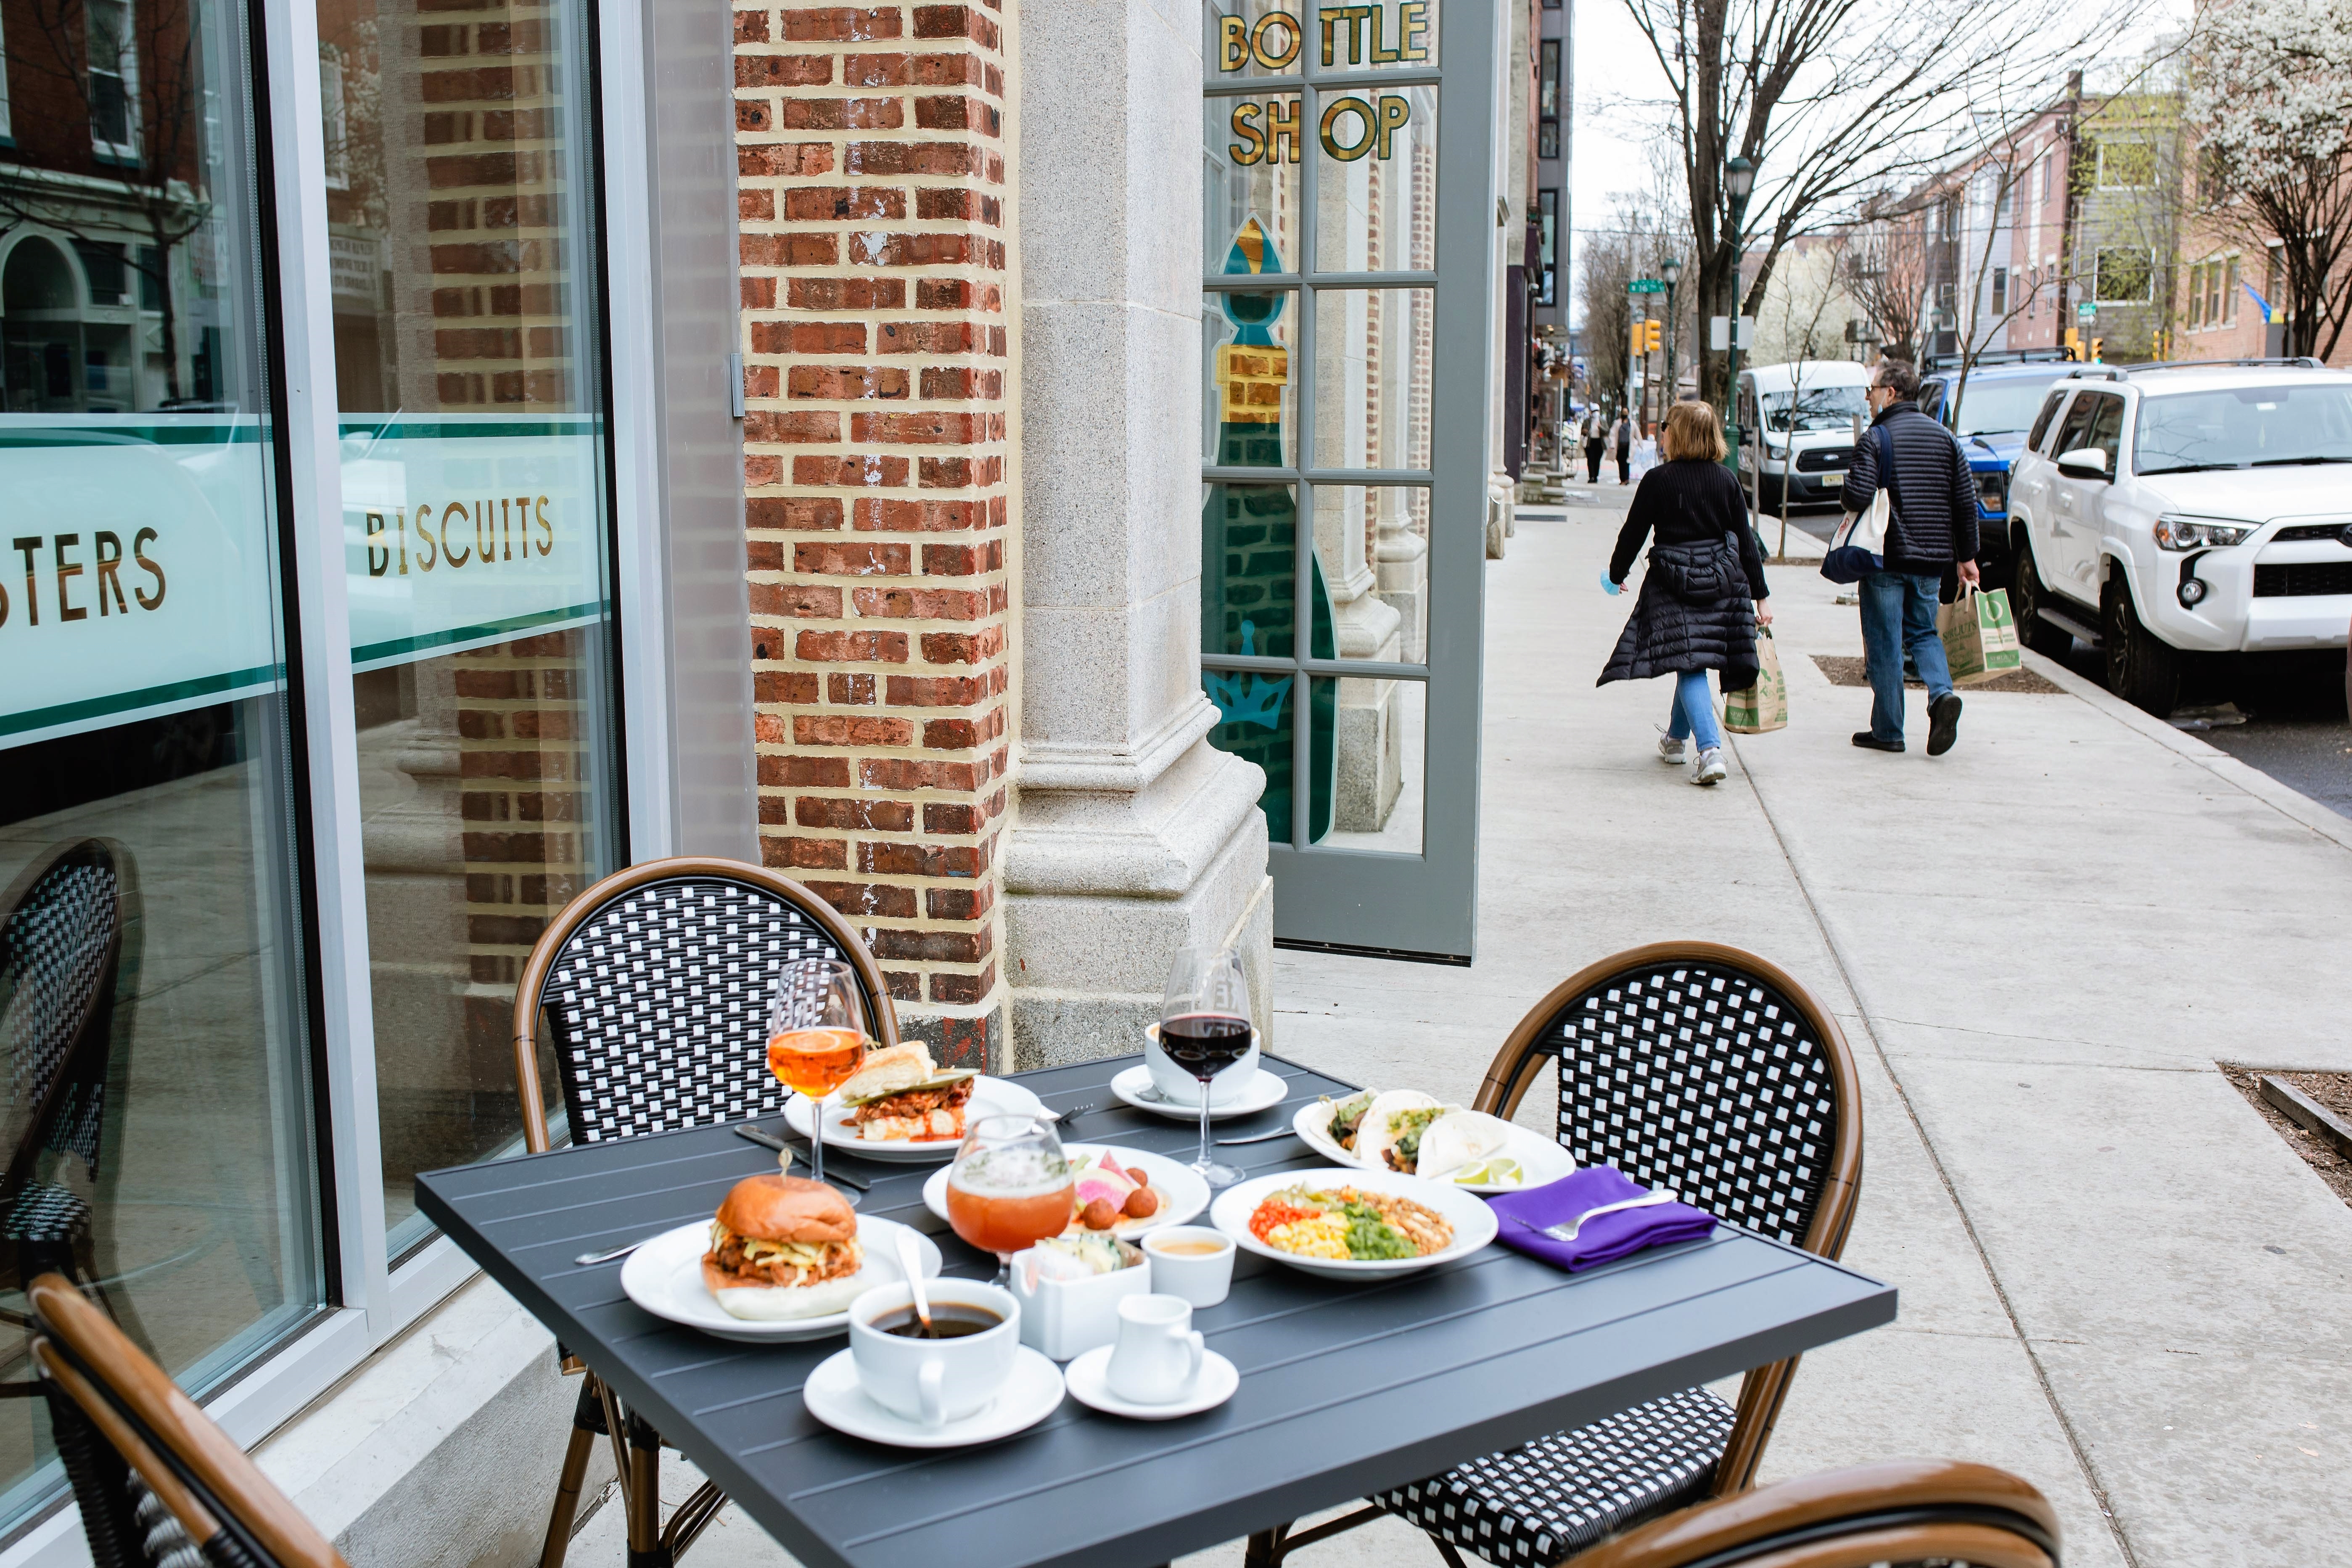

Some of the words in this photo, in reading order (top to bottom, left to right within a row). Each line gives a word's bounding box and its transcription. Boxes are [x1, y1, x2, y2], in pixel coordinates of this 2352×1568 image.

[1219, 2, 1427, 72] BOTTLE
[1229, 95, 1411, 166] SHOP
[366, 494, 554, 578] BISCUITS
